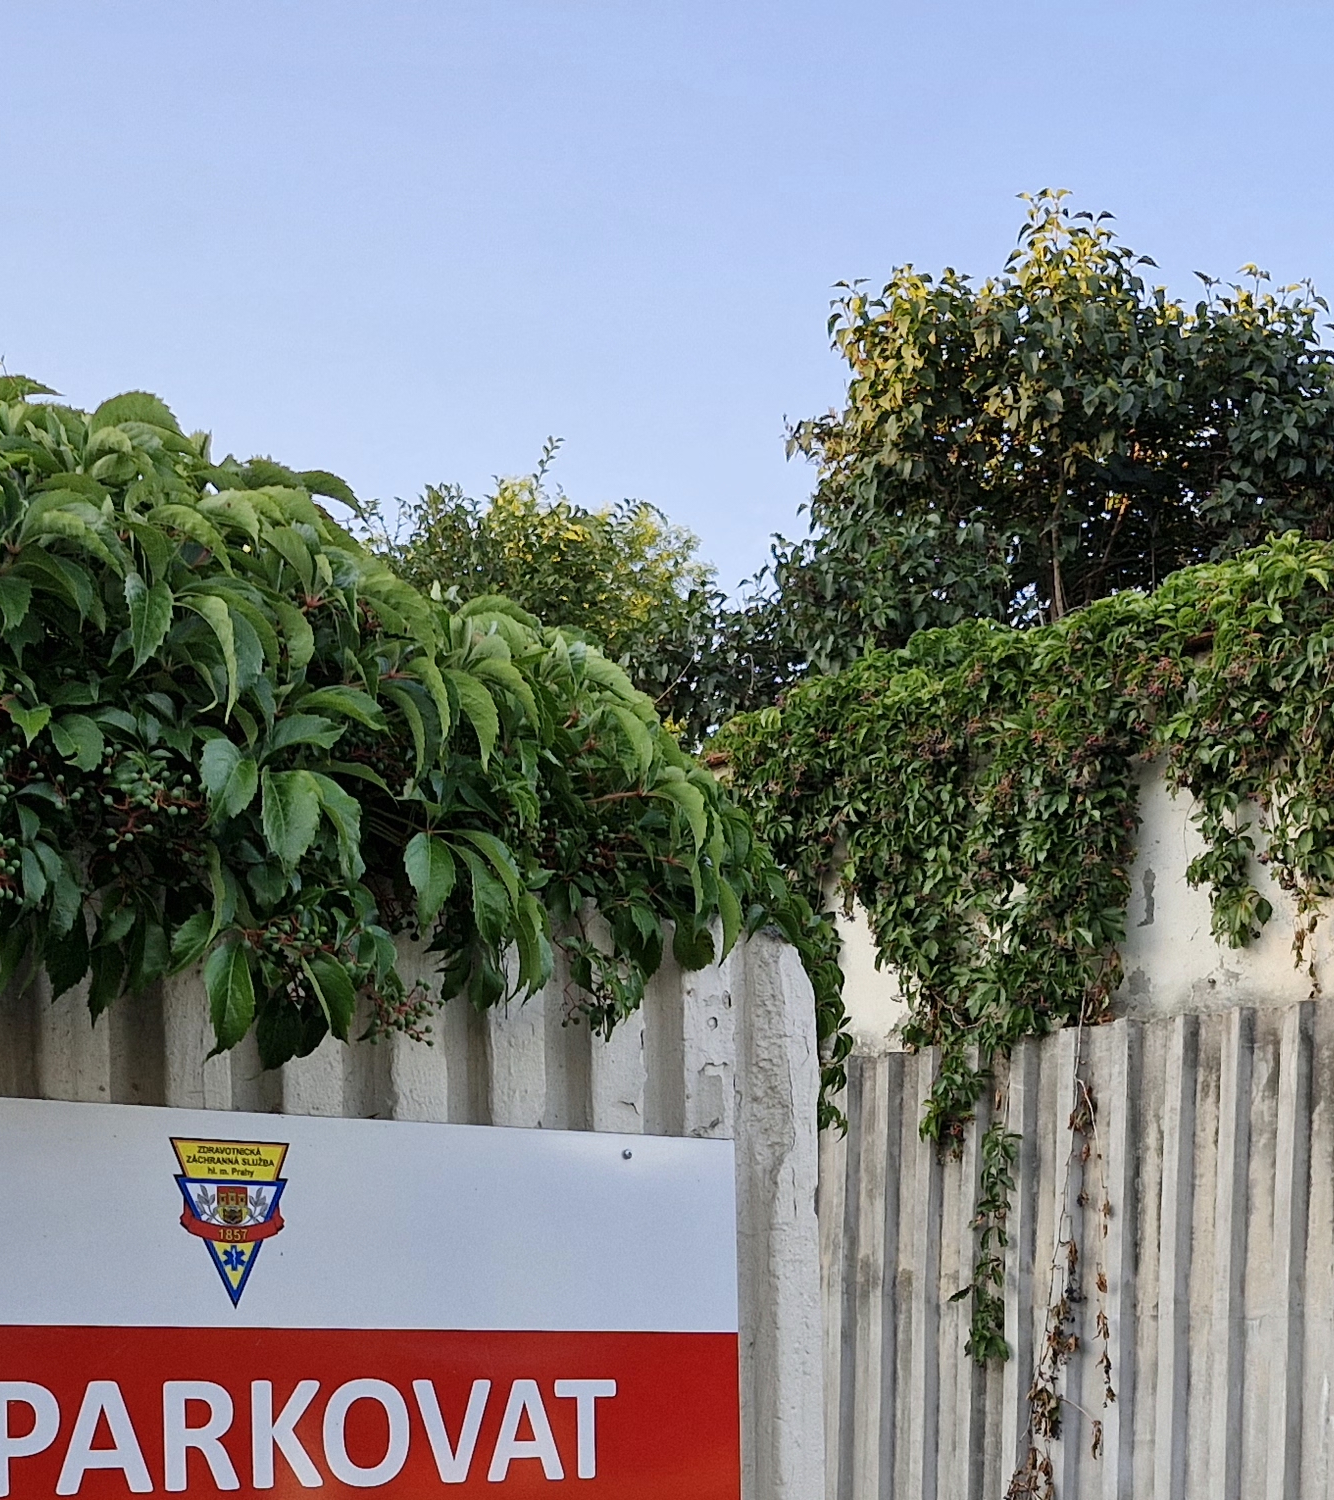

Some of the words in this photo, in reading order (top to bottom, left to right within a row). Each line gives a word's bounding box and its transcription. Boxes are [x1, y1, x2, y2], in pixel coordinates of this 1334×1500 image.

[186, 1154, 239, 1165] ZÁCHRANNÁ
[241, 1157, 275, 1167] SLUŽBA
[231, 1168, 254, 1178] Prahy
[219, 1228, 248, 1241] 1857
